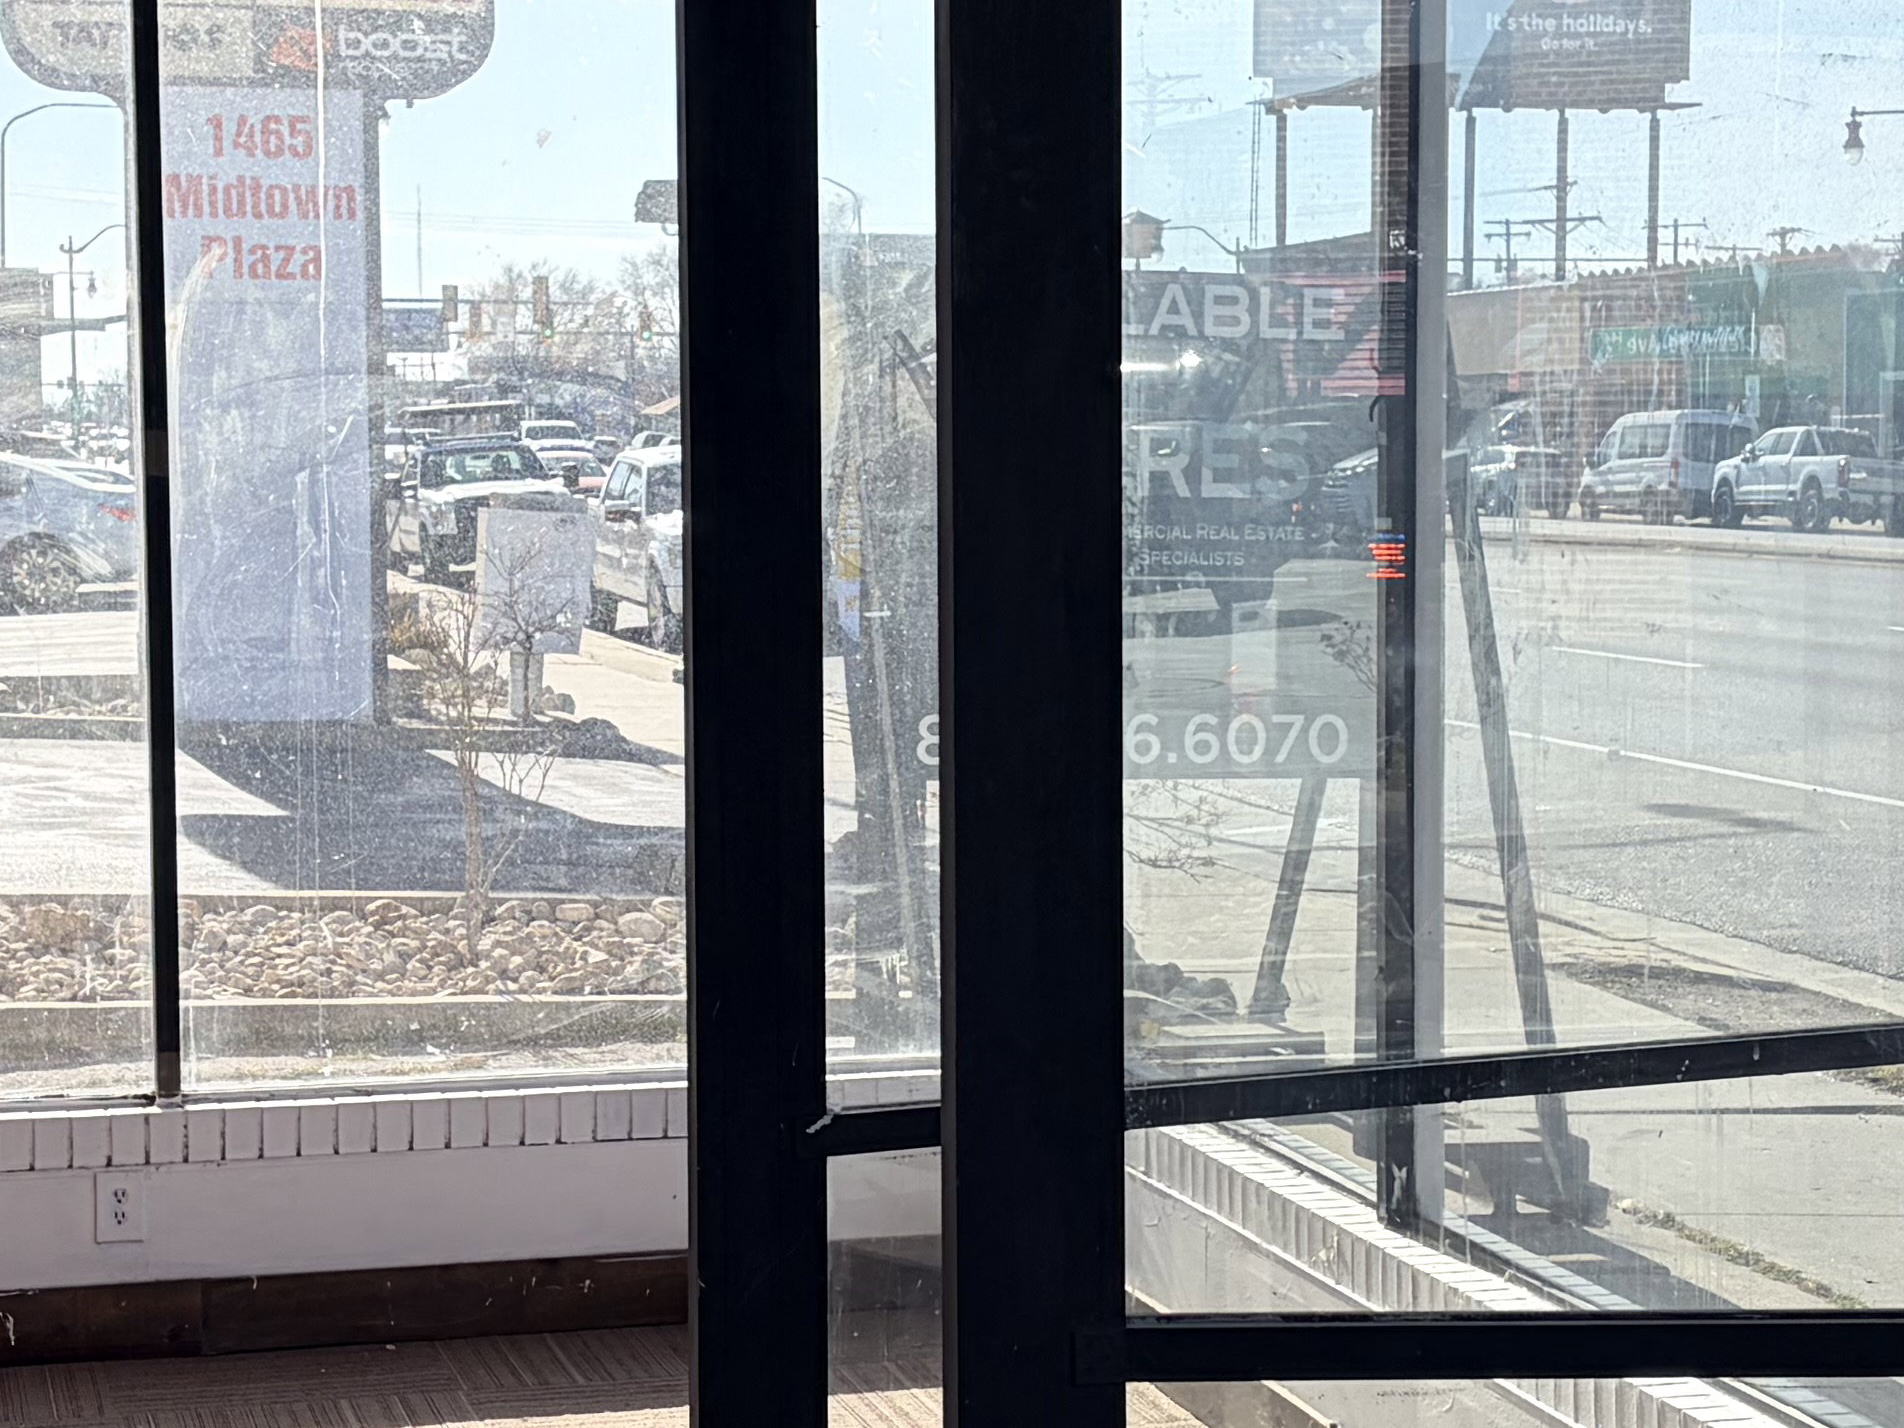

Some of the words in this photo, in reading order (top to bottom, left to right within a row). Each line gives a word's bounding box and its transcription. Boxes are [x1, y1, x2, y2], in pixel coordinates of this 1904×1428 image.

[338, 23, 472, 61] boost
[1520, 11, 1557, 33] the
[1561, 36, 1581, 51] for
[206, 113, 314, 160] 1465
[164, 172, 357, 221] Midtown
[200, 235, 323, 281] Plaza
